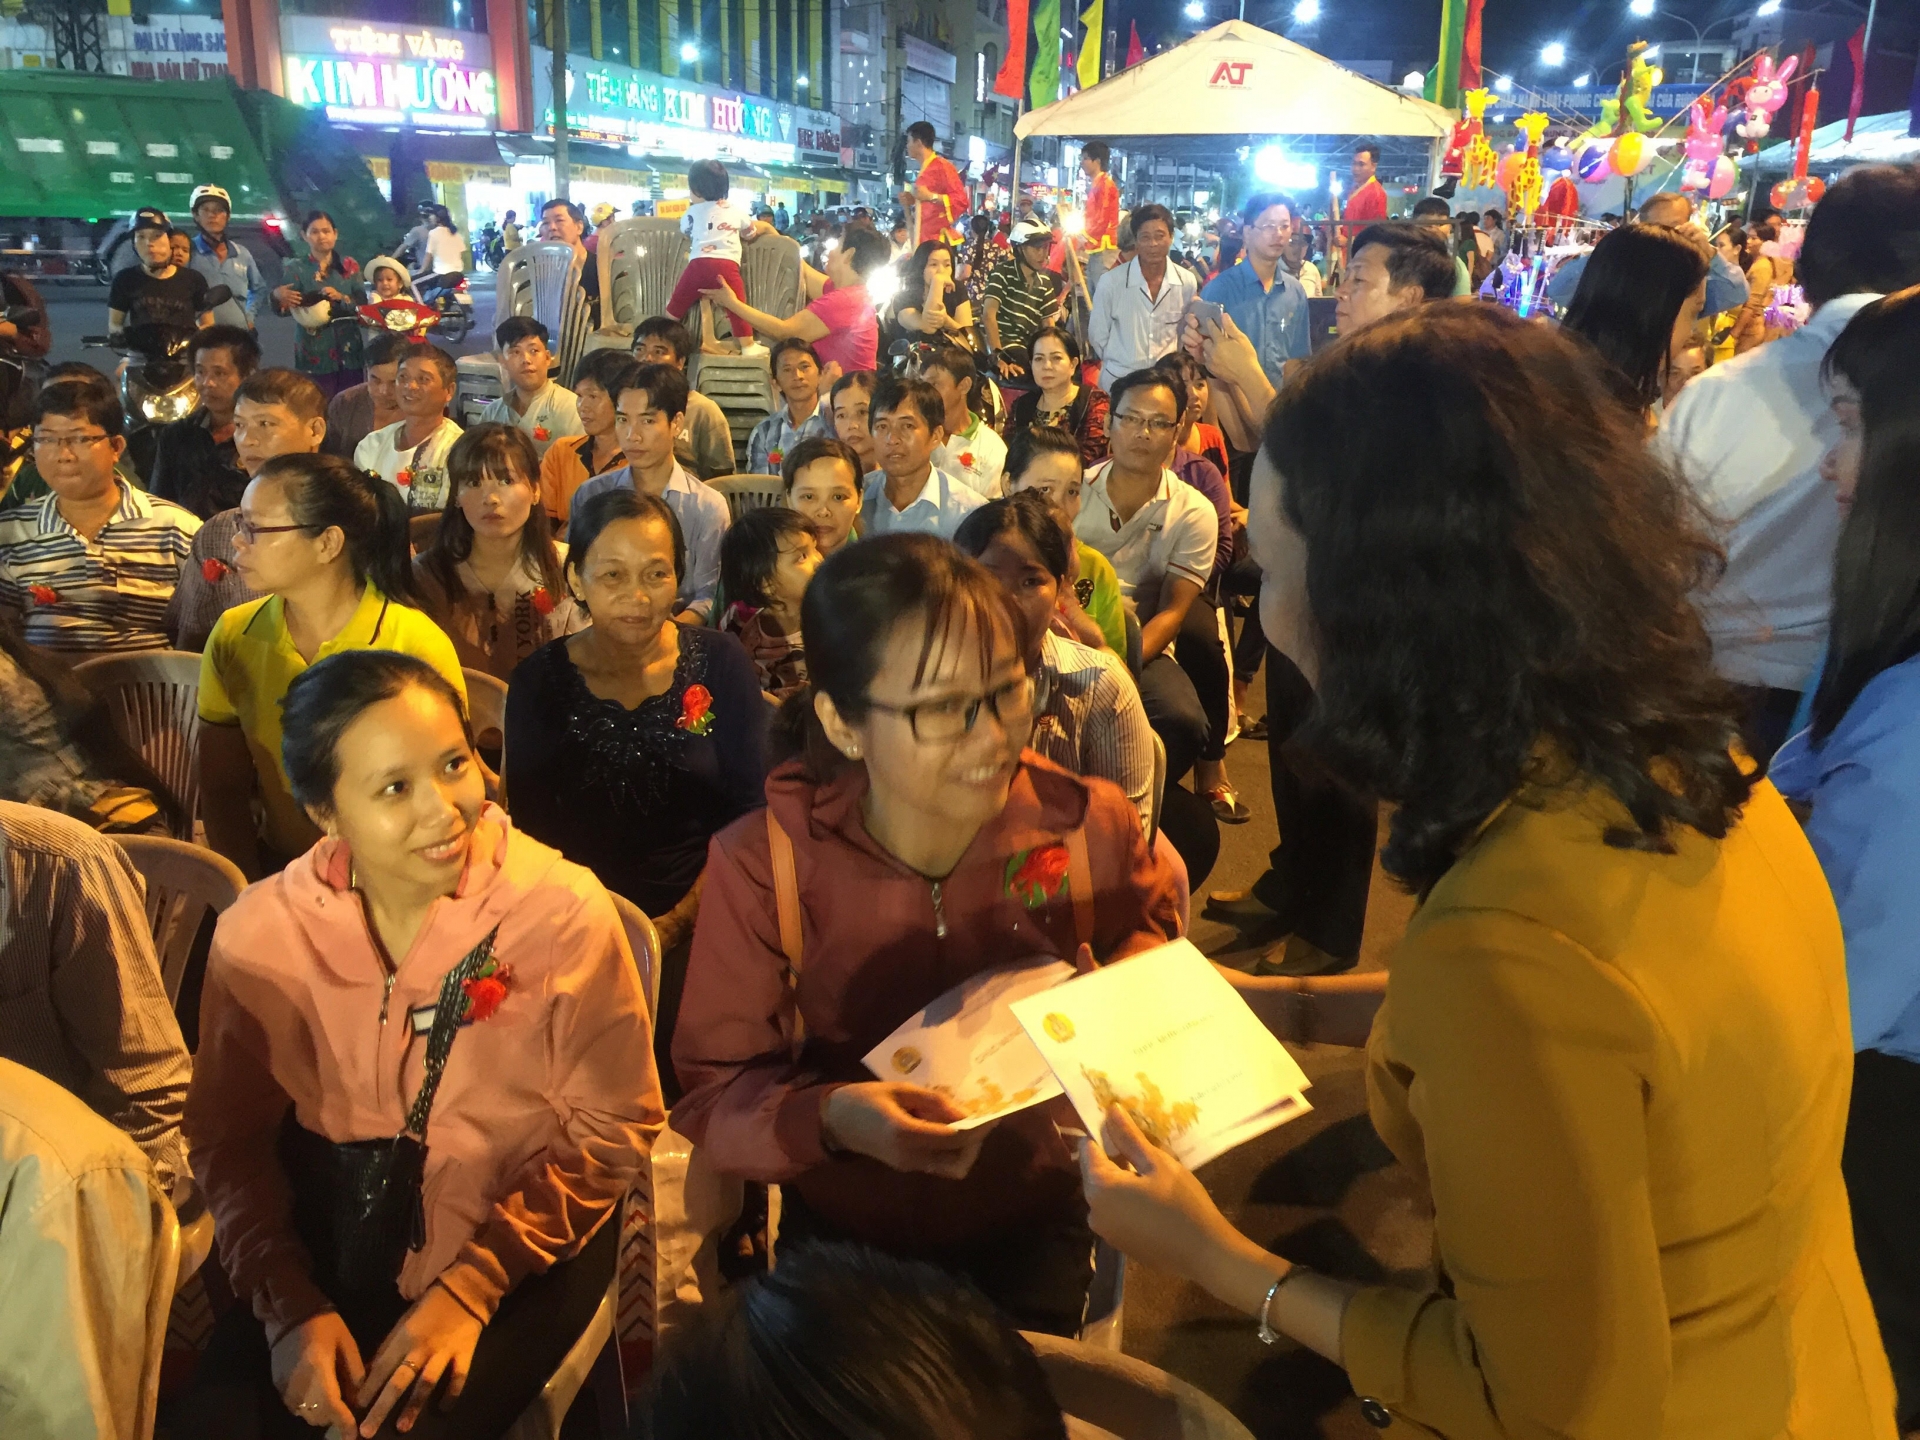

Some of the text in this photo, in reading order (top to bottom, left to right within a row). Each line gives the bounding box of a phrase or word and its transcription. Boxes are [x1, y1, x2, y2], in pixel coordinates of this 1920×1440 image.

[329, 25, 465, 61] TIỆM VÀNG
[287, 56, 495, 116] KIM HƯƠNG
[662, 86, 707, 128] KIM
[712, 94, 774, 139] HƯƠNG
[515, 589, 533, 649] YORK
